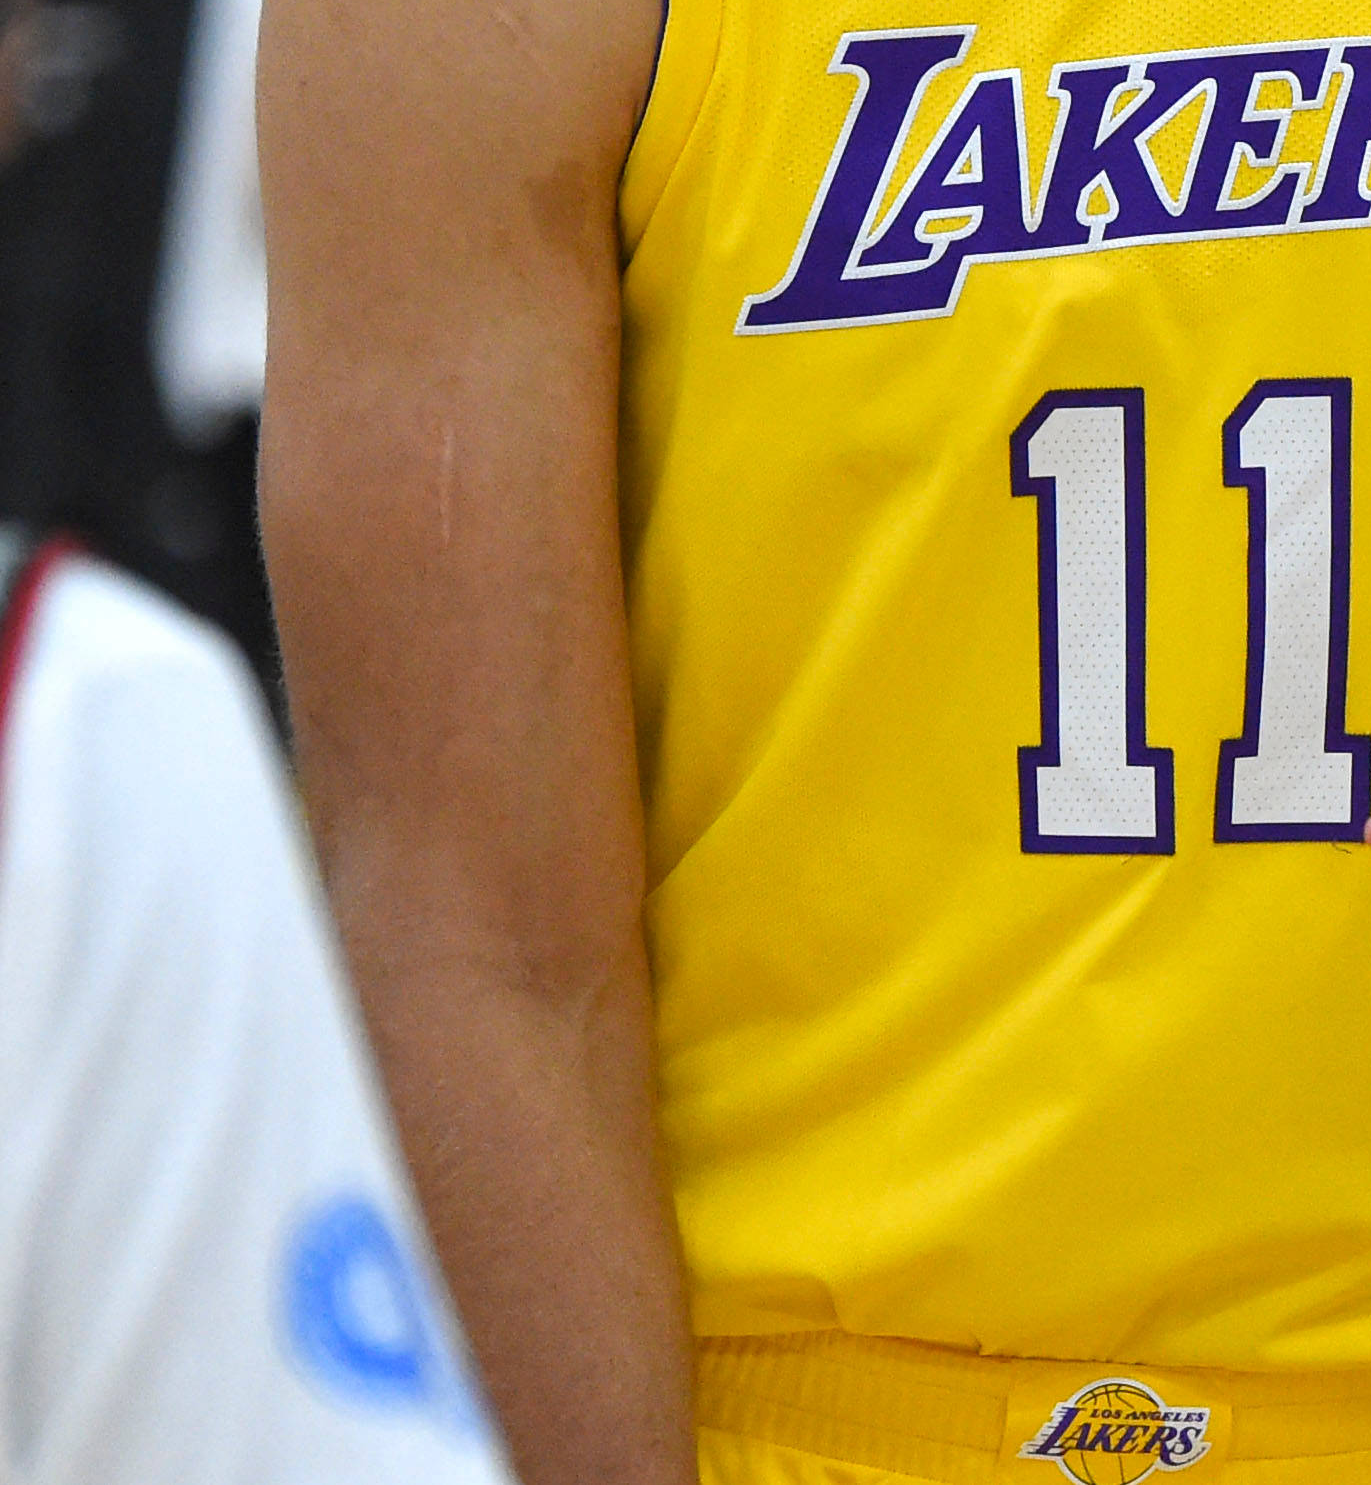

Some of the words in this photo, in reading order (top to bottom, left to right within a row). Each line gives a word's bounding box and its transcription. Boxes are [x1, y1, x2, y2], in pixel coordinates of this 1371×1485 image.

[1089, 1408, 1121, 1420] LOS
[1125, 1410, 1206, 1422] ANGELES
[1027, 1406, 1206, 1467] LAKERS
